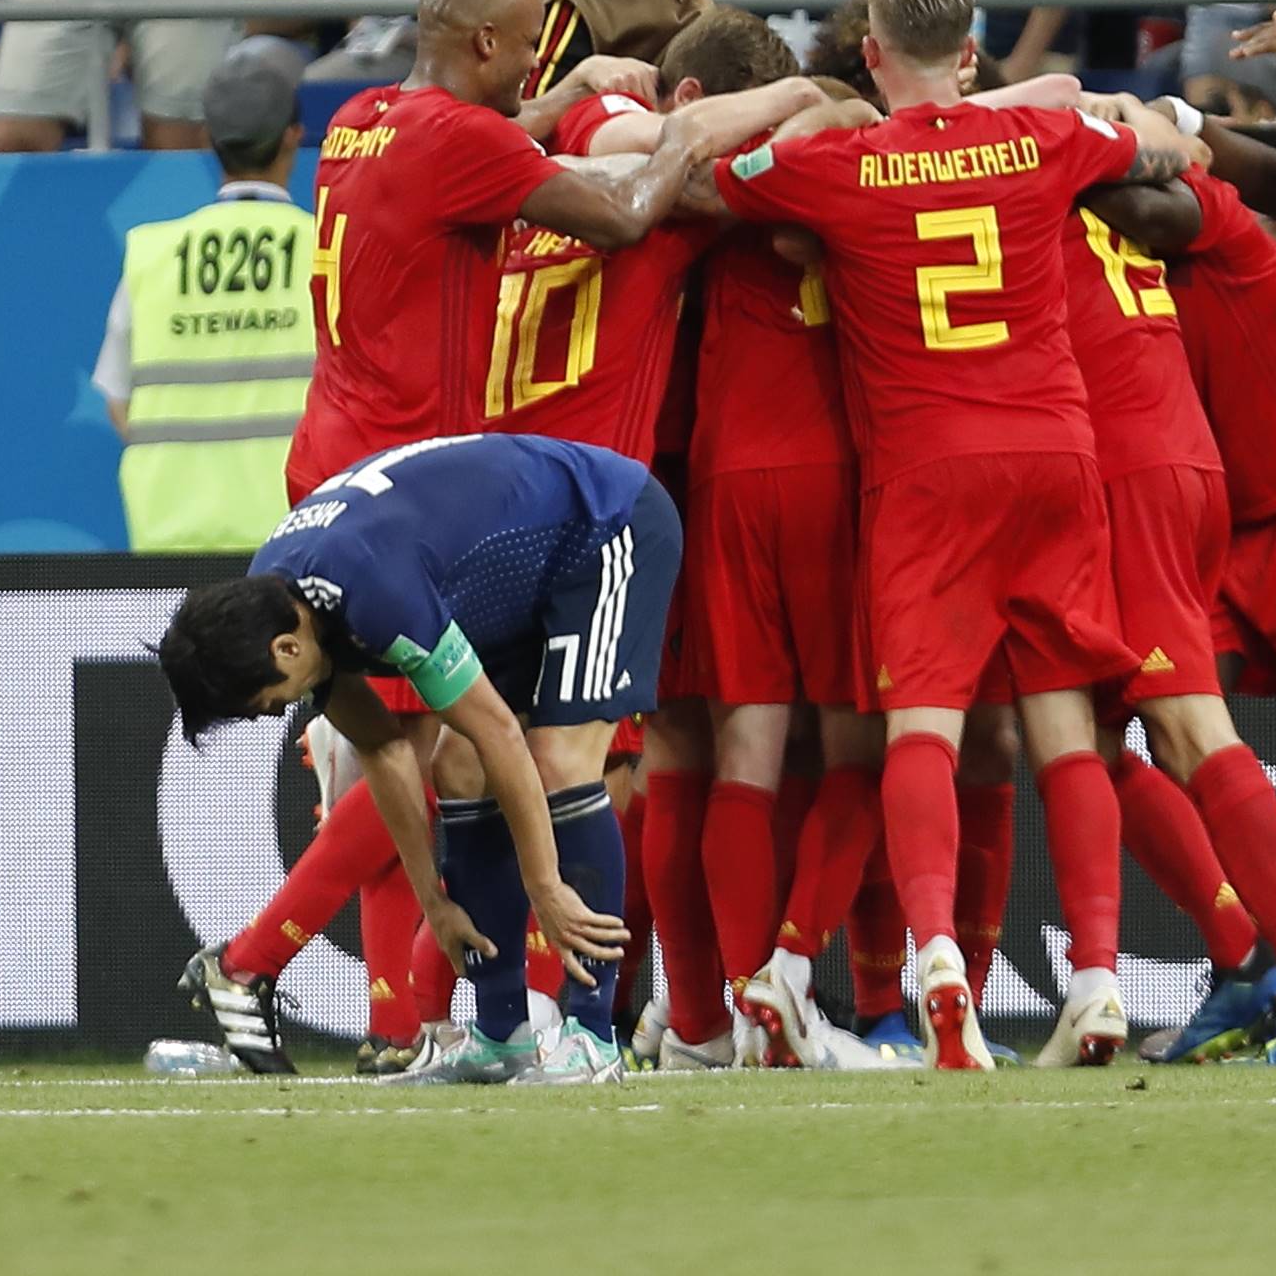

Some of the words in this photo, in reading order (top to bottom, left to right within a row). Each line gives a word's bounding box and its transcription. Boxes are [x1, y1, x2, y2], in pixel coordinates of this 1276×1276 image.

[860, 136, 1040, 187] ALDERWEIRELD
[175, 226, 297, 295] 18261
[312, 185, 348, 347] 4
[915, 205, 1010, 351] 2
[171, 307, 299, 335] STEWARD
[485, 256, 602, 419] 10
